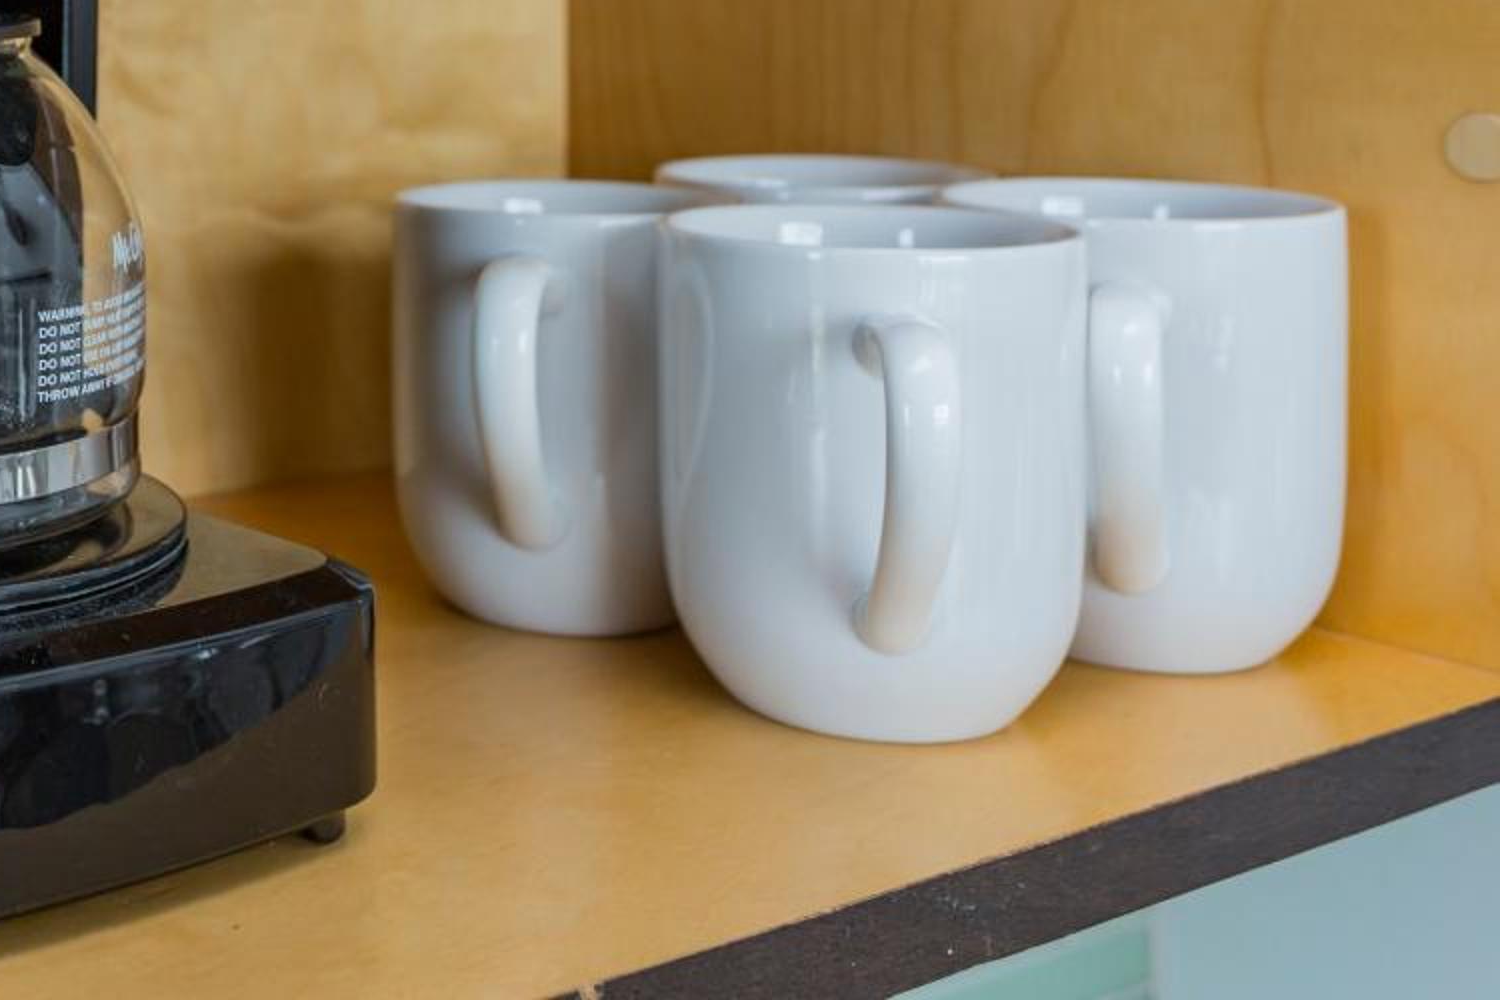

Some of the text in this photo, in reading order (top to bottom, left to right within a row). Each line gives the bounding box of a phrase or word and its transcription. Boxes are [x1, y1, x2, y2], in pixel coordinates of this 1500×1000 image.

[39, 326, 57, 340] DO
[59, 322, 81, 337] NOT
[39, 342, 57, 355] DO
[59, 337, 81, 352] NOT
[39, 358, 57, 371] DO
[59, 353, 81, 369] NOT
[38, 374, 57, 387] DO
[59, 369, 81, 385] NOT
[38, 384, 80, 404] THROW
